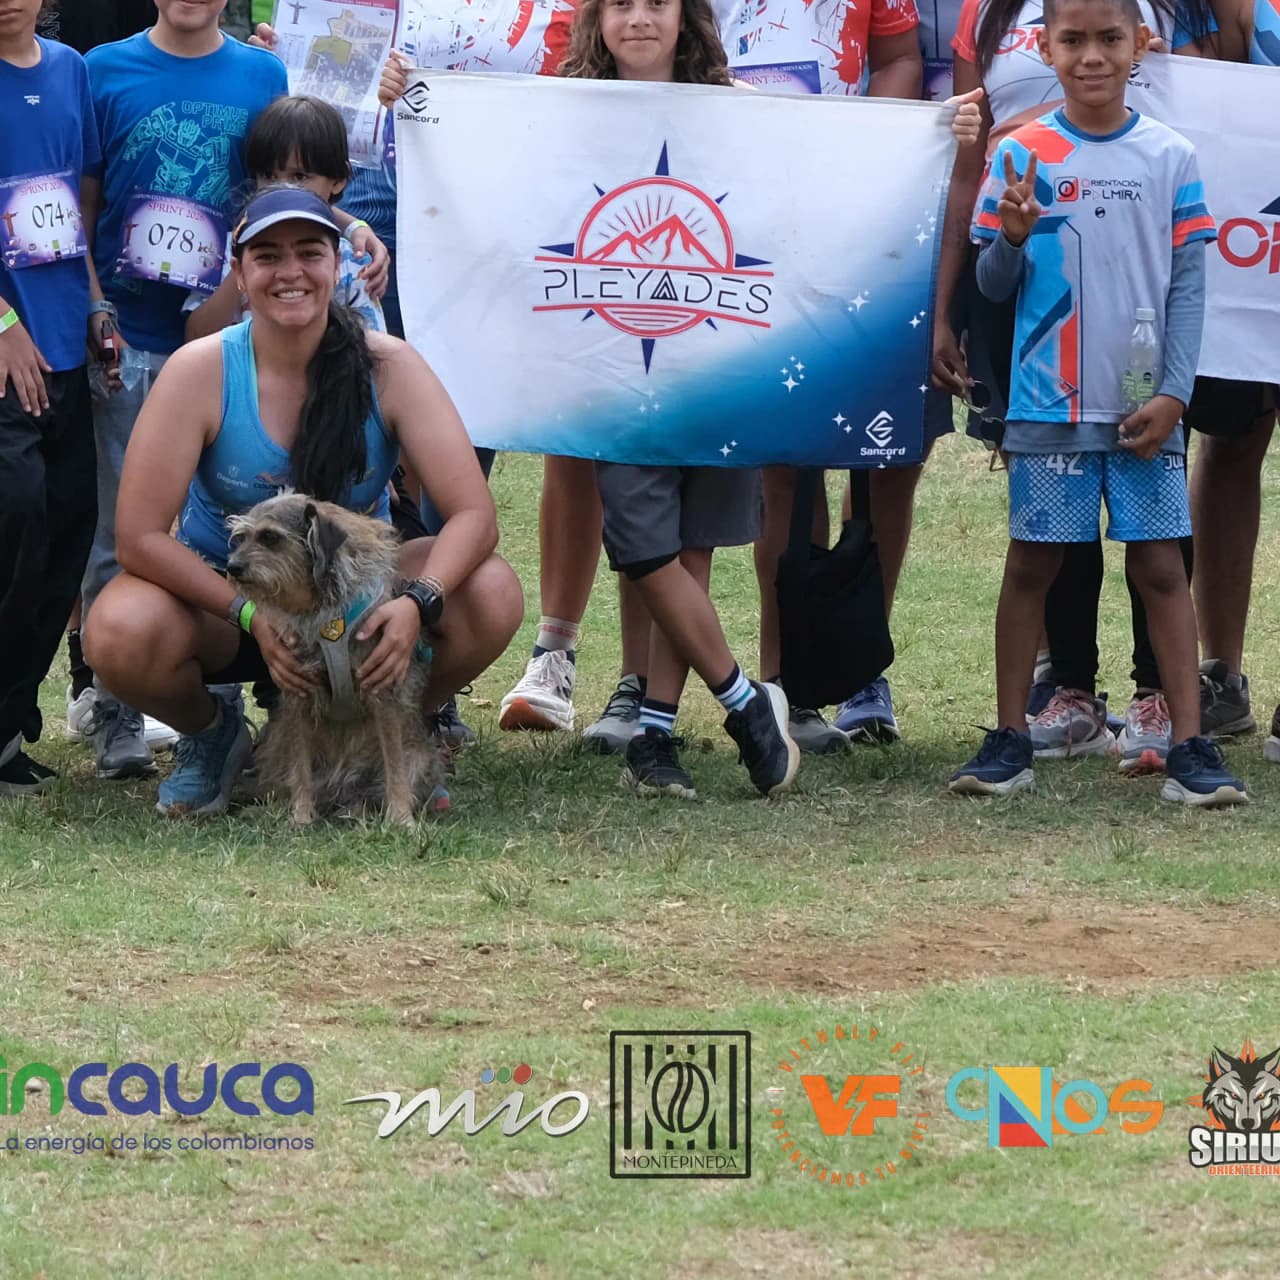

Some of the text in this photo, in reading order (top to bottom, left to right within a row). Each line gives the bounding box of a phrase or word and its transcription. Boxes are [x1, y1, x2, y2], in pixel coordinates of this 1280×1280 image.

[740, 74, 770, 86] PRINT
[396, 112, 440, 124] Sancord
[31, 200, 65, 229] 074
[148, 223, 195, 254] 078
[544, 268, 772, 313] PLEYADES
[860, 445, 906, 456] Sancord
